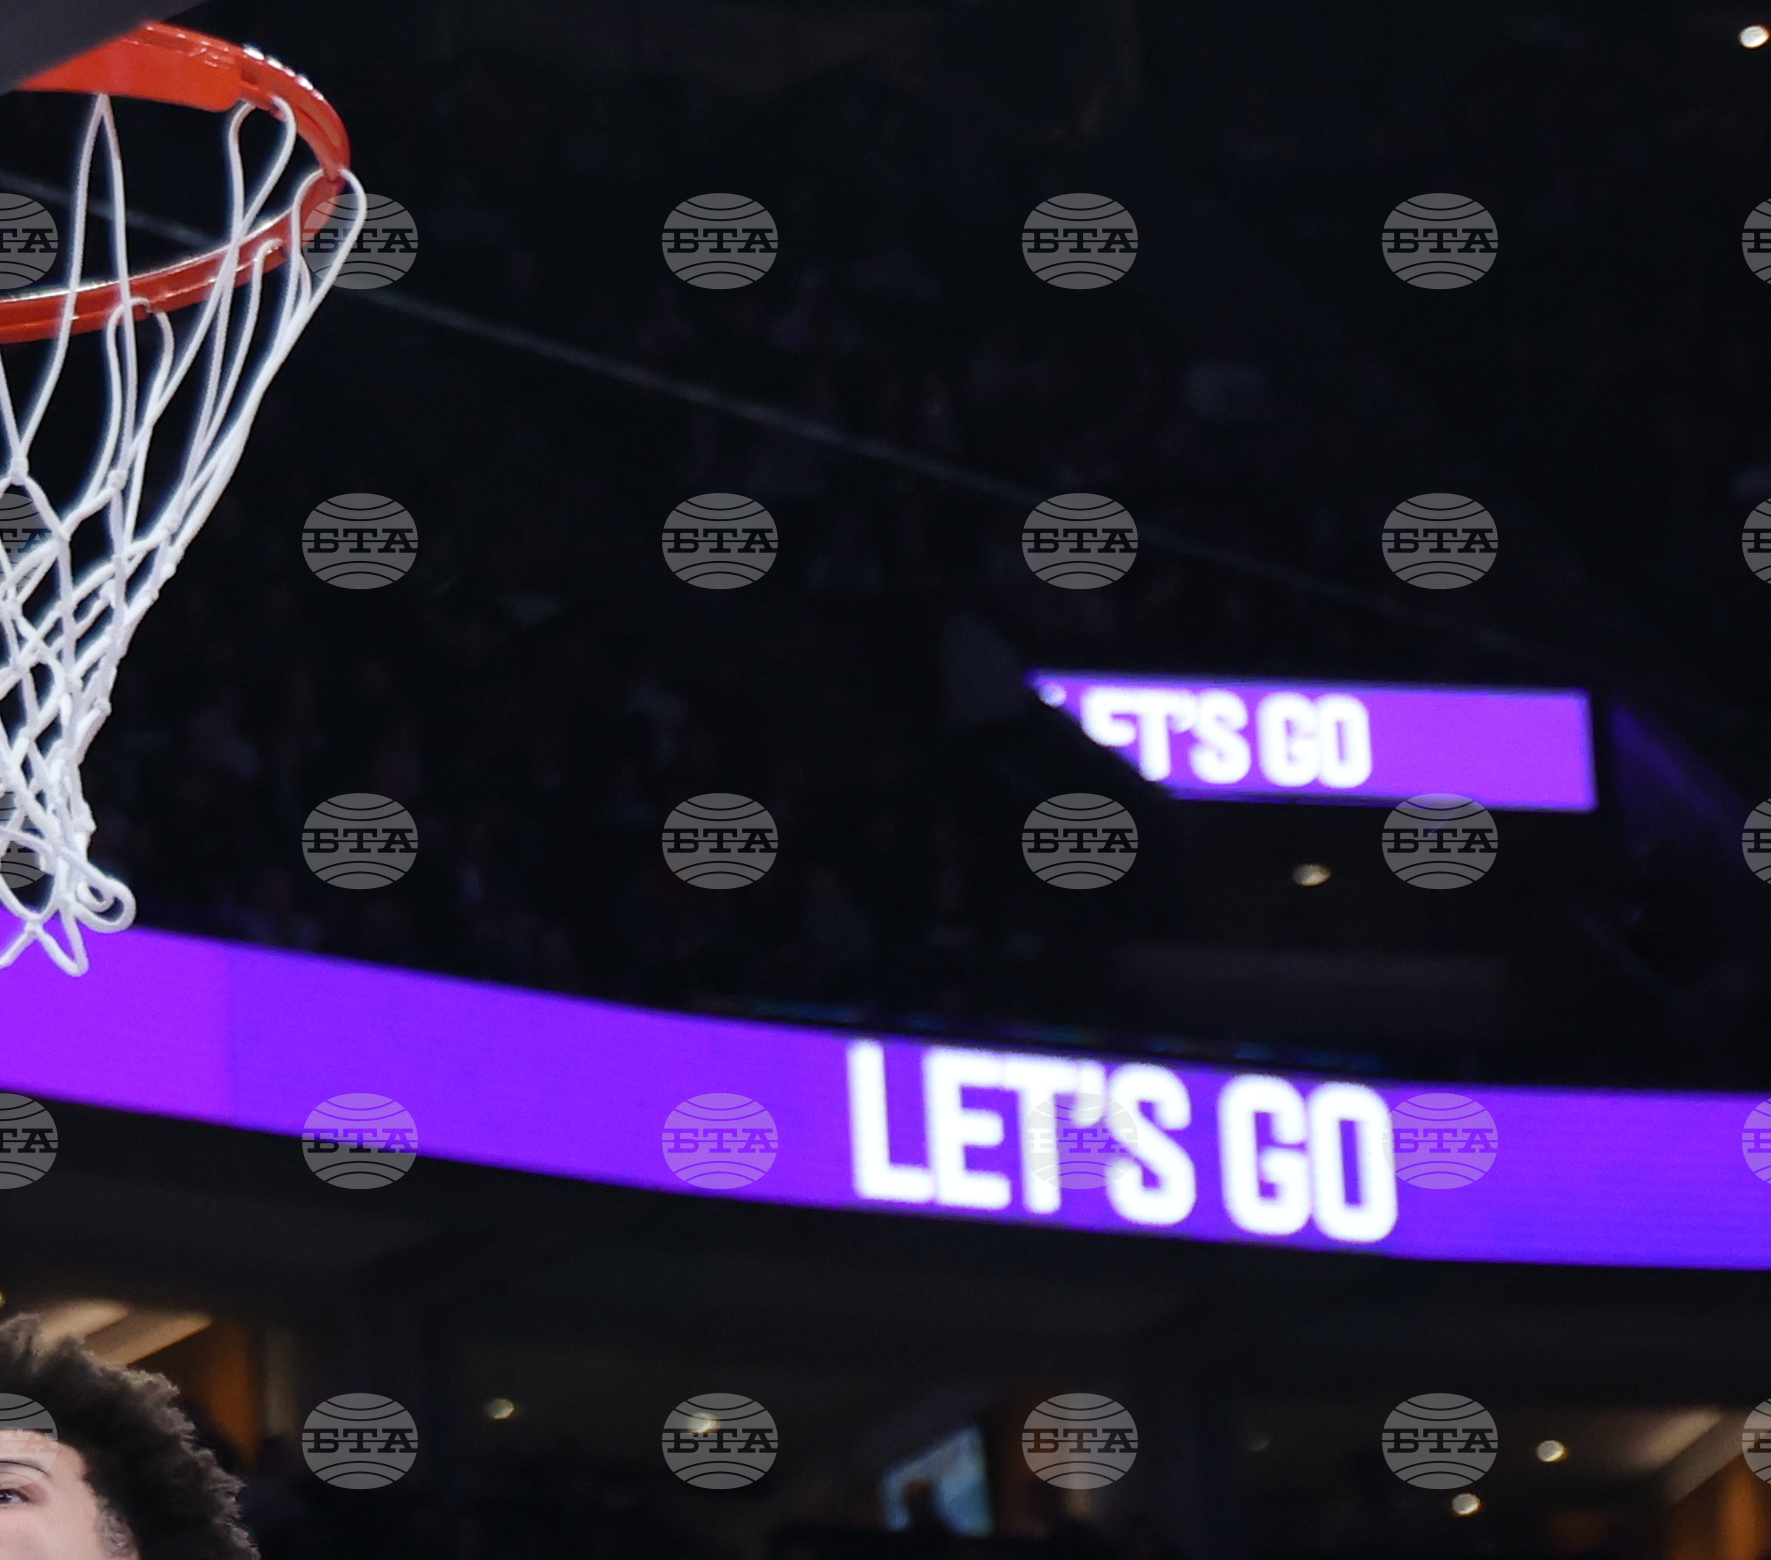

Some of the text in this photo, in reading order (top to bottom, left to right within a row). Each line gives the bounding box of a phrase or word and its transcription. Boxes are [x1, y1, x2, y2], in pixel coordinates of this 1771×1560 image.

[1040, 683, 1373, 790] ET'S GO
[846, 1039, 1399, 1243] LET'S GO
